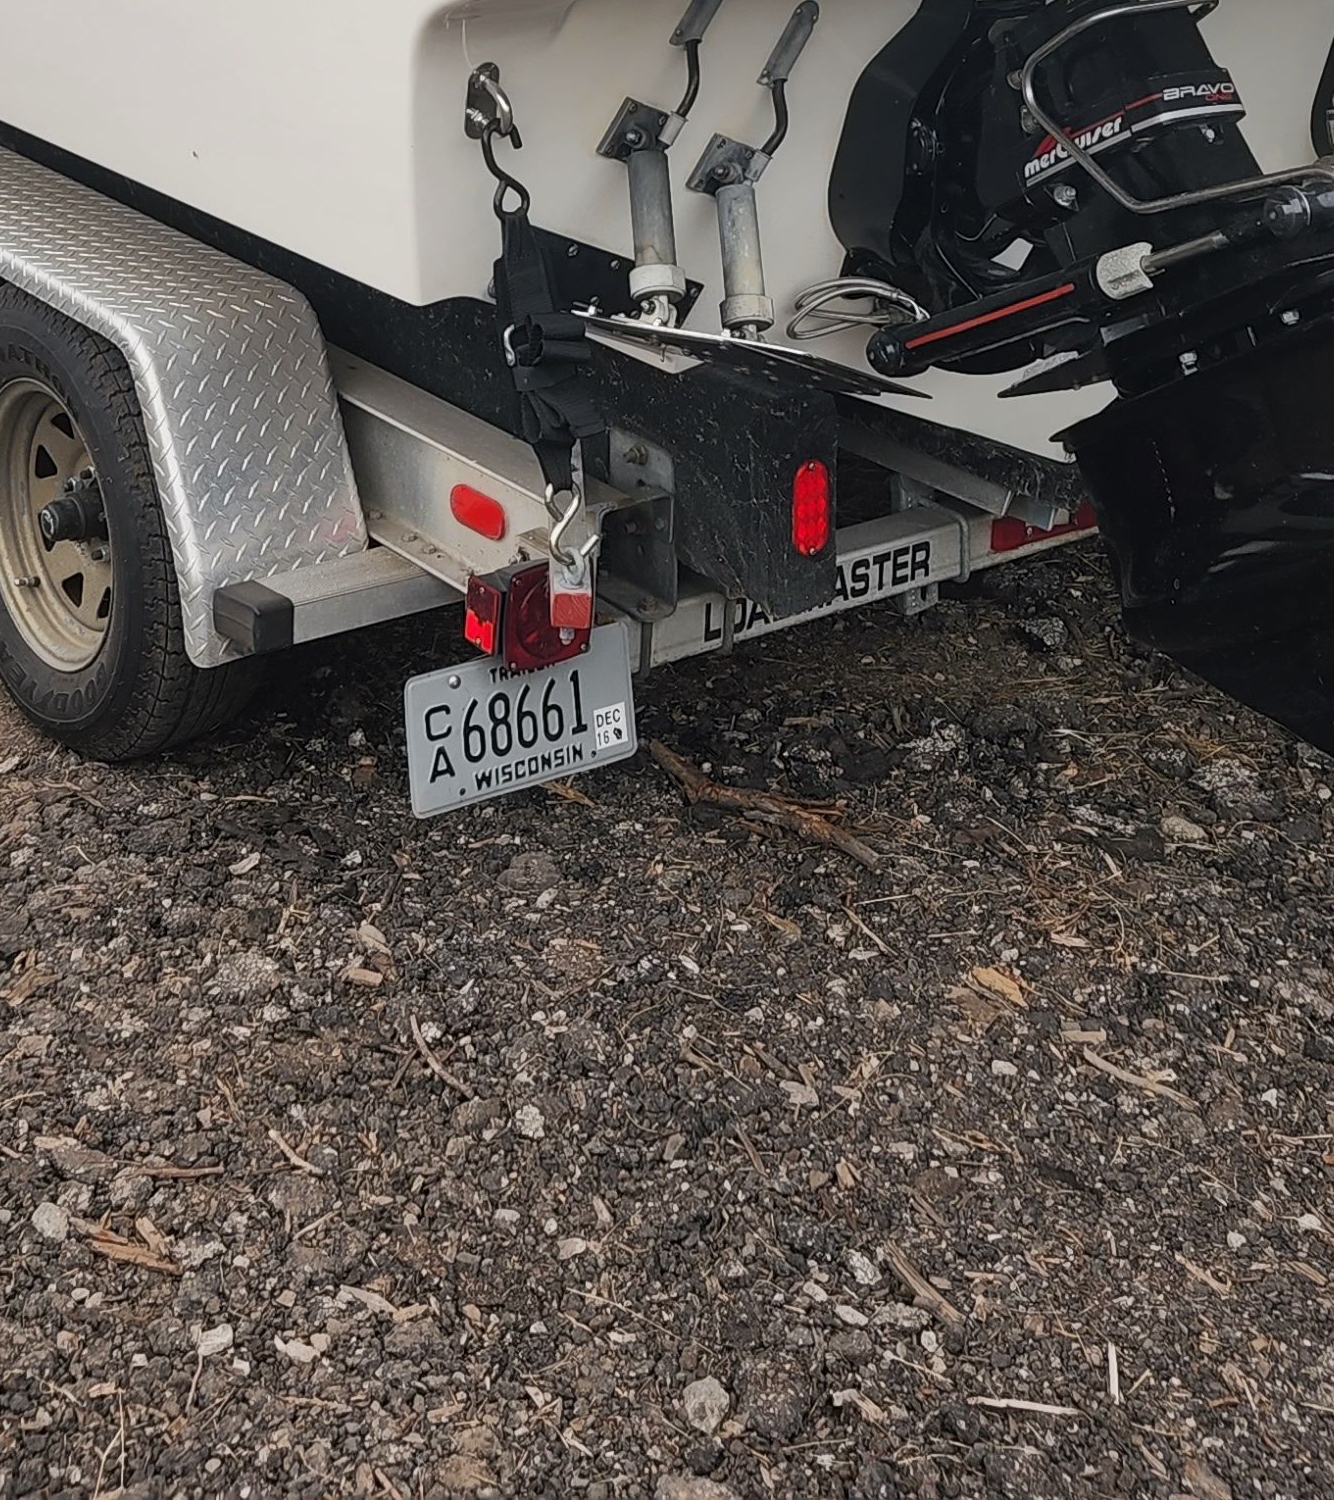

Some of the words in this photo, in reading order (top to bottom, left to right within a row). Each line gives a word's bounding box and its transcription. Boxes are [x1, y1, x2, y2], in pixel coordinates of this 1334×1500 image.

[1162, 82, 1235, 101] BRAVO
[463, 669, 589, 764] 68661
[595, 708, 622, 730] DEC
[597, 728, 611, 748] 16
[474, 742, 584, 792] WISCONSIN
